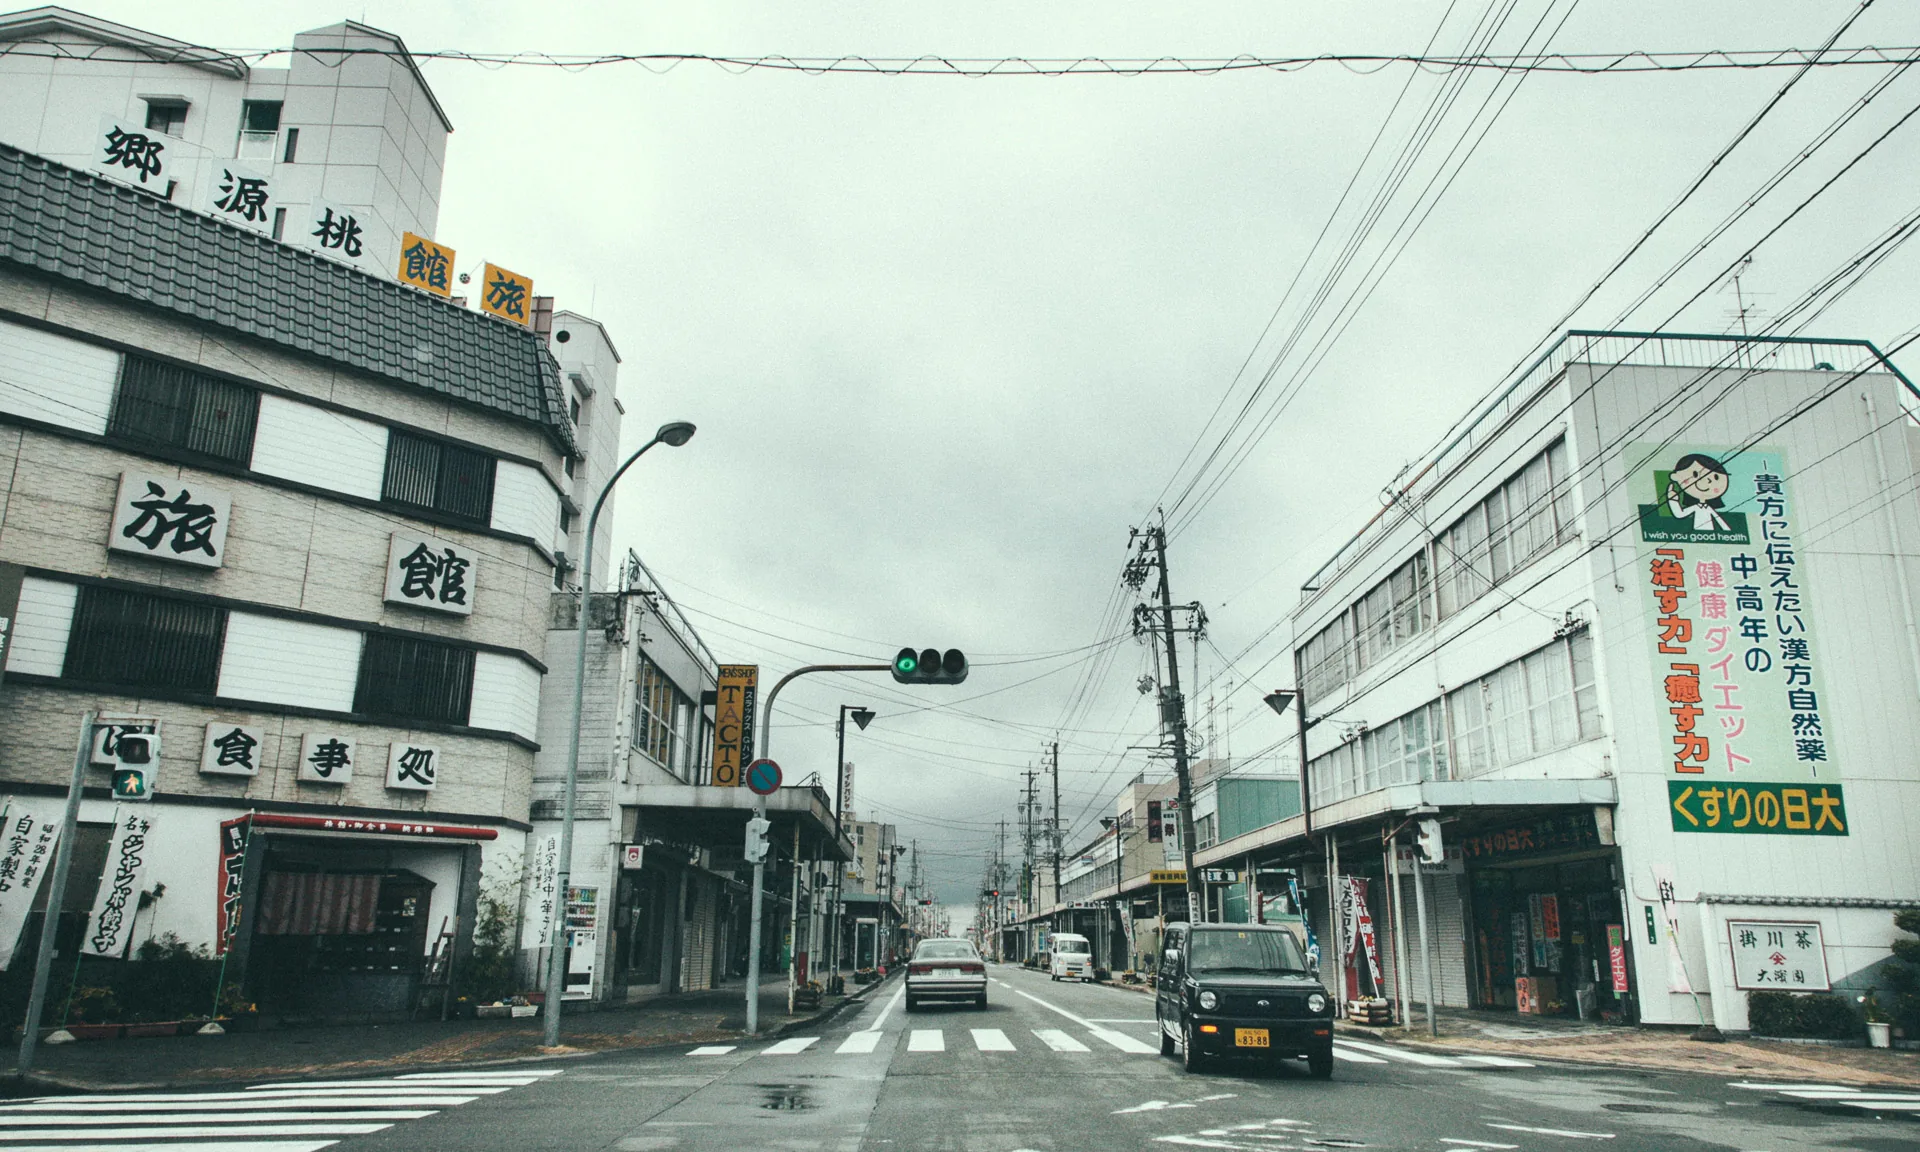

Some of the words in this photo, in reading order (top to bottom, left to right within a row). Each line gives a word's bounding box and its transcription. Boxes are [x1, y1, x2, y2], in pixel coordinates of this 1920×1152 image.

[123, 481, 470, 605] 旅館
[1670, 533, 1688, 542] you
[1690, 532, 1715, 542] good
[1717, 533, 1747, 542] health
[1730, 553, 1772, 673] 中高年の
[1695, 560, 1751, 773] 健康ダイエット
[716, 686, 741, 783] TACTO
[1673, 786, 1844, 832] くすりの日大
[1739, 930, 1812, 950] 掛川茶
[1243, 1036, 1268, 1045] 83-88
